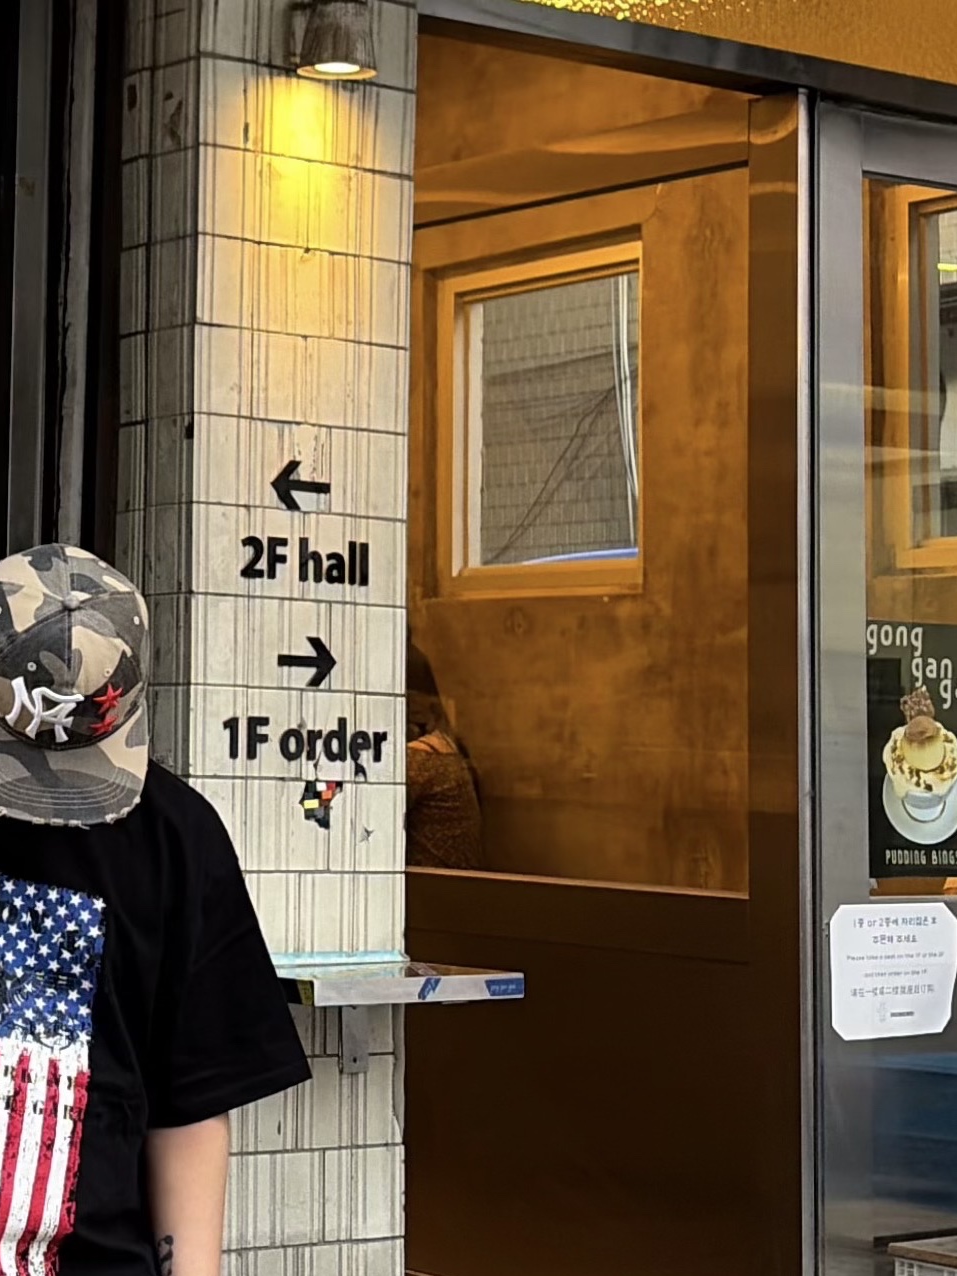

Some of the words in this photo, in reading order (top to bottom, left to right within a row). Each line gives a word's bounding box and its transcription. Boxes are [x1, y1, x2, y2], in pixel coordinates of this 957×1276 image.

[240, 536, 288, 580] 2F
[298, 537, 369, 587] hall
[866, 624, 923, 657] gong
[911, 657, 953, 687] gan
[939, 679, 957, 709] g
[223, 716, 270, 761] 1F
[279, 717, 387, 762] order
[885, 849, 927, 865] PUDDING
